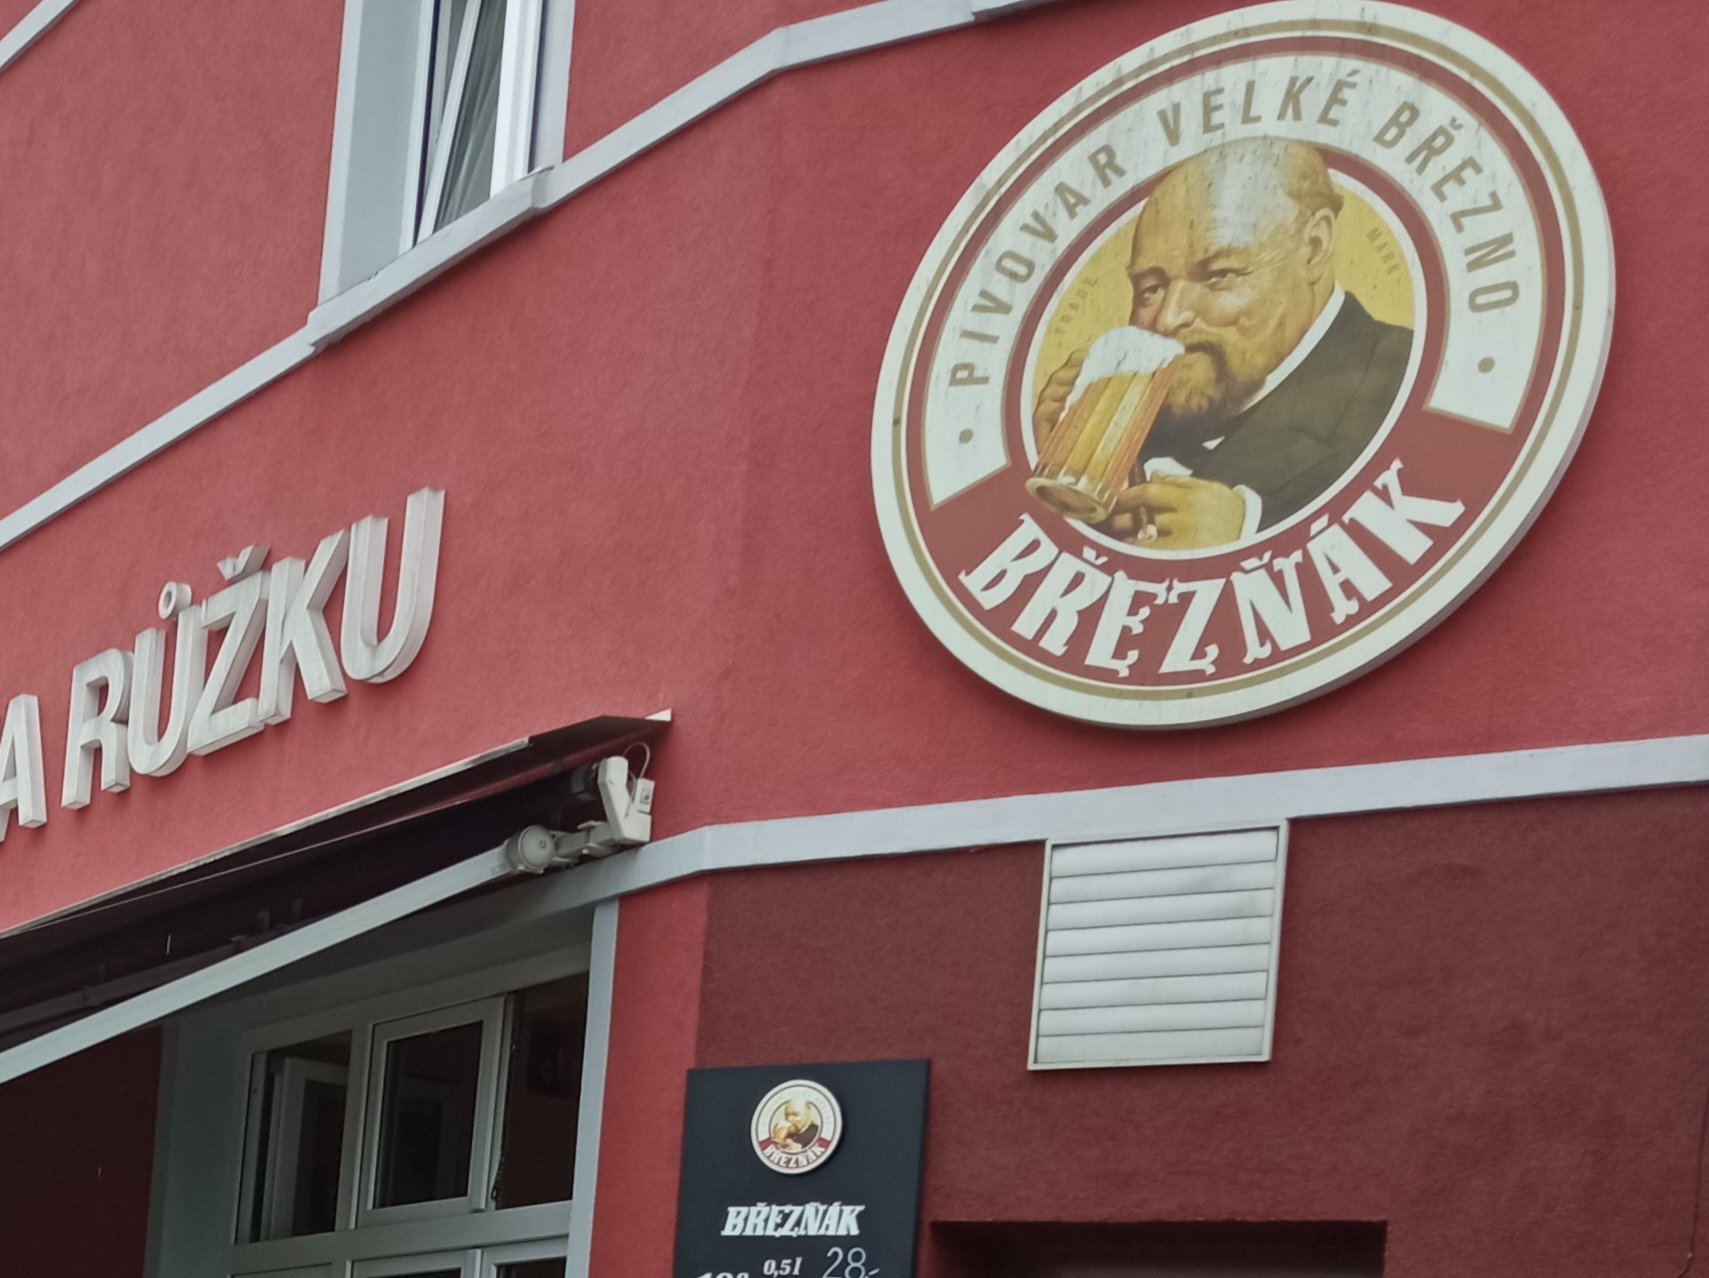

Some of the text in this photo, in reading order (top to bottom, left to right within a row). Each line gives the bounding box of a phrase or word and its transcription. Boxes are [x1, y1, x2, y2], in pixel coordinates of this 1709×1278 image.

[948, 67, 1521, 388] PIVOVAR VELKÉ BŘEZNO
[1365, 226, 1404, 277] MARK
[61, 486, 446, 811] RŮŽKU
[958, 457, 1466, 678] BŘEZŇÁK
[720, 1201, 866, 1238] BŘEZŇÁK
